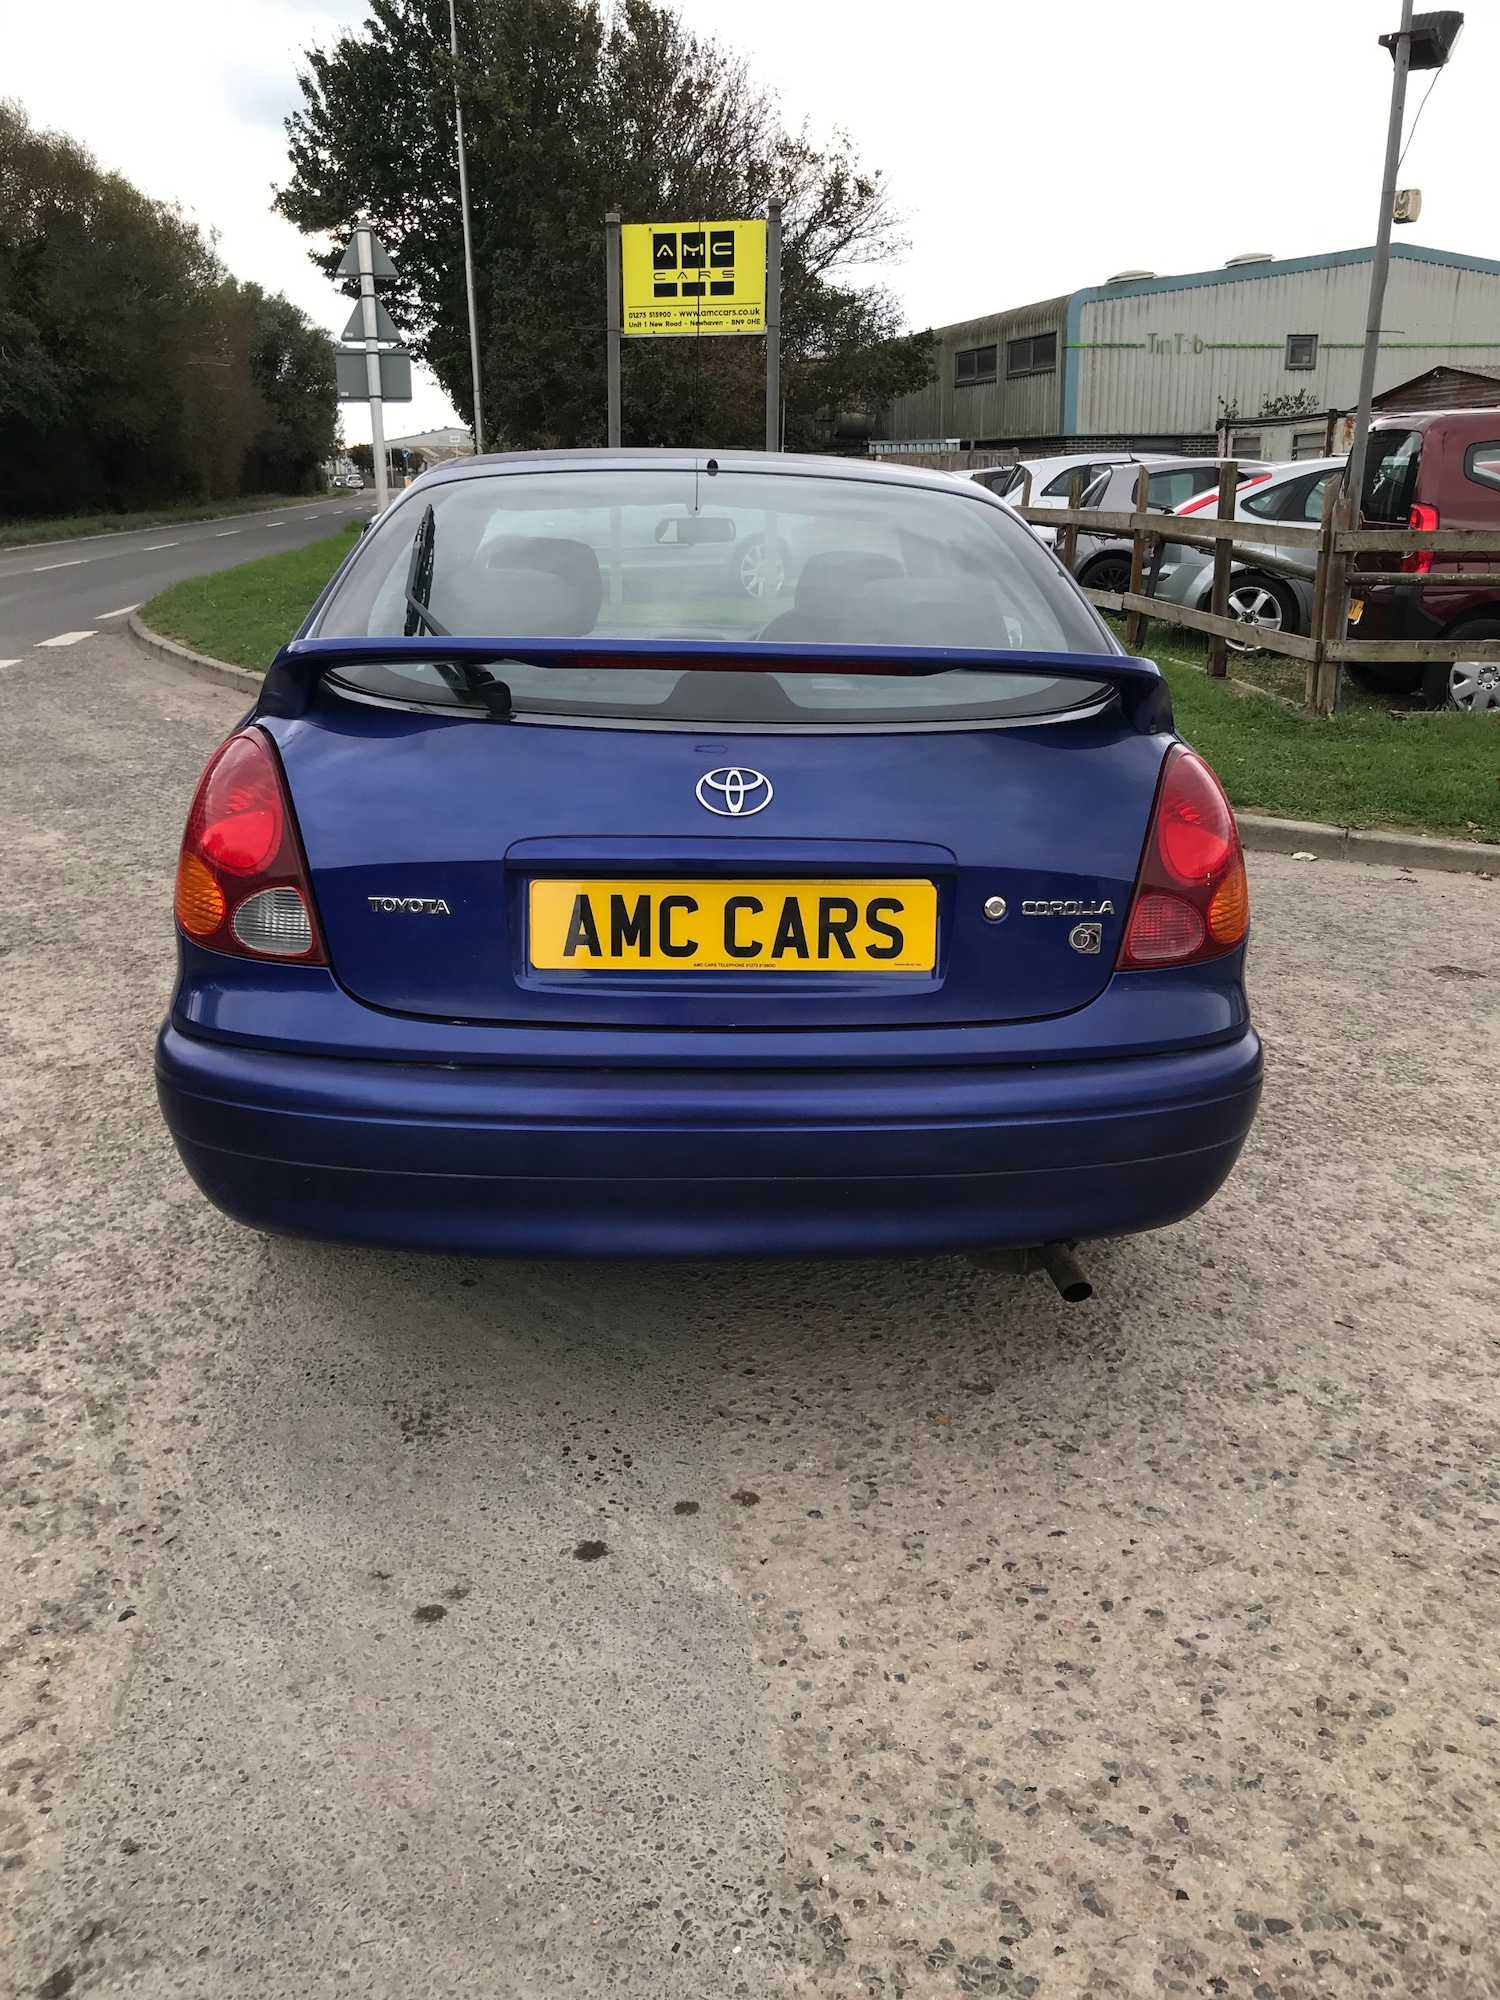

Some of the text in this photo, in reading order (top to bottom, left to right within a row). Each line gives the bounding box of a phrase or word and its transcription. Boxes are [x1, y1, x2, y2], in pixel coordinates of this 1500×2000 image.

[656, 242, 732, 257] AMC
[653, 270, 735, 281] CARS
[628, 311, 646, 319] 01273
[679, 308, 760, 317] www.amccars.co.uk
[367, 895, 451, 915] TOYOTA
[1021, 900, 1115, 916] COROLLA
[563, 894, 905, 959] AMC CARS
